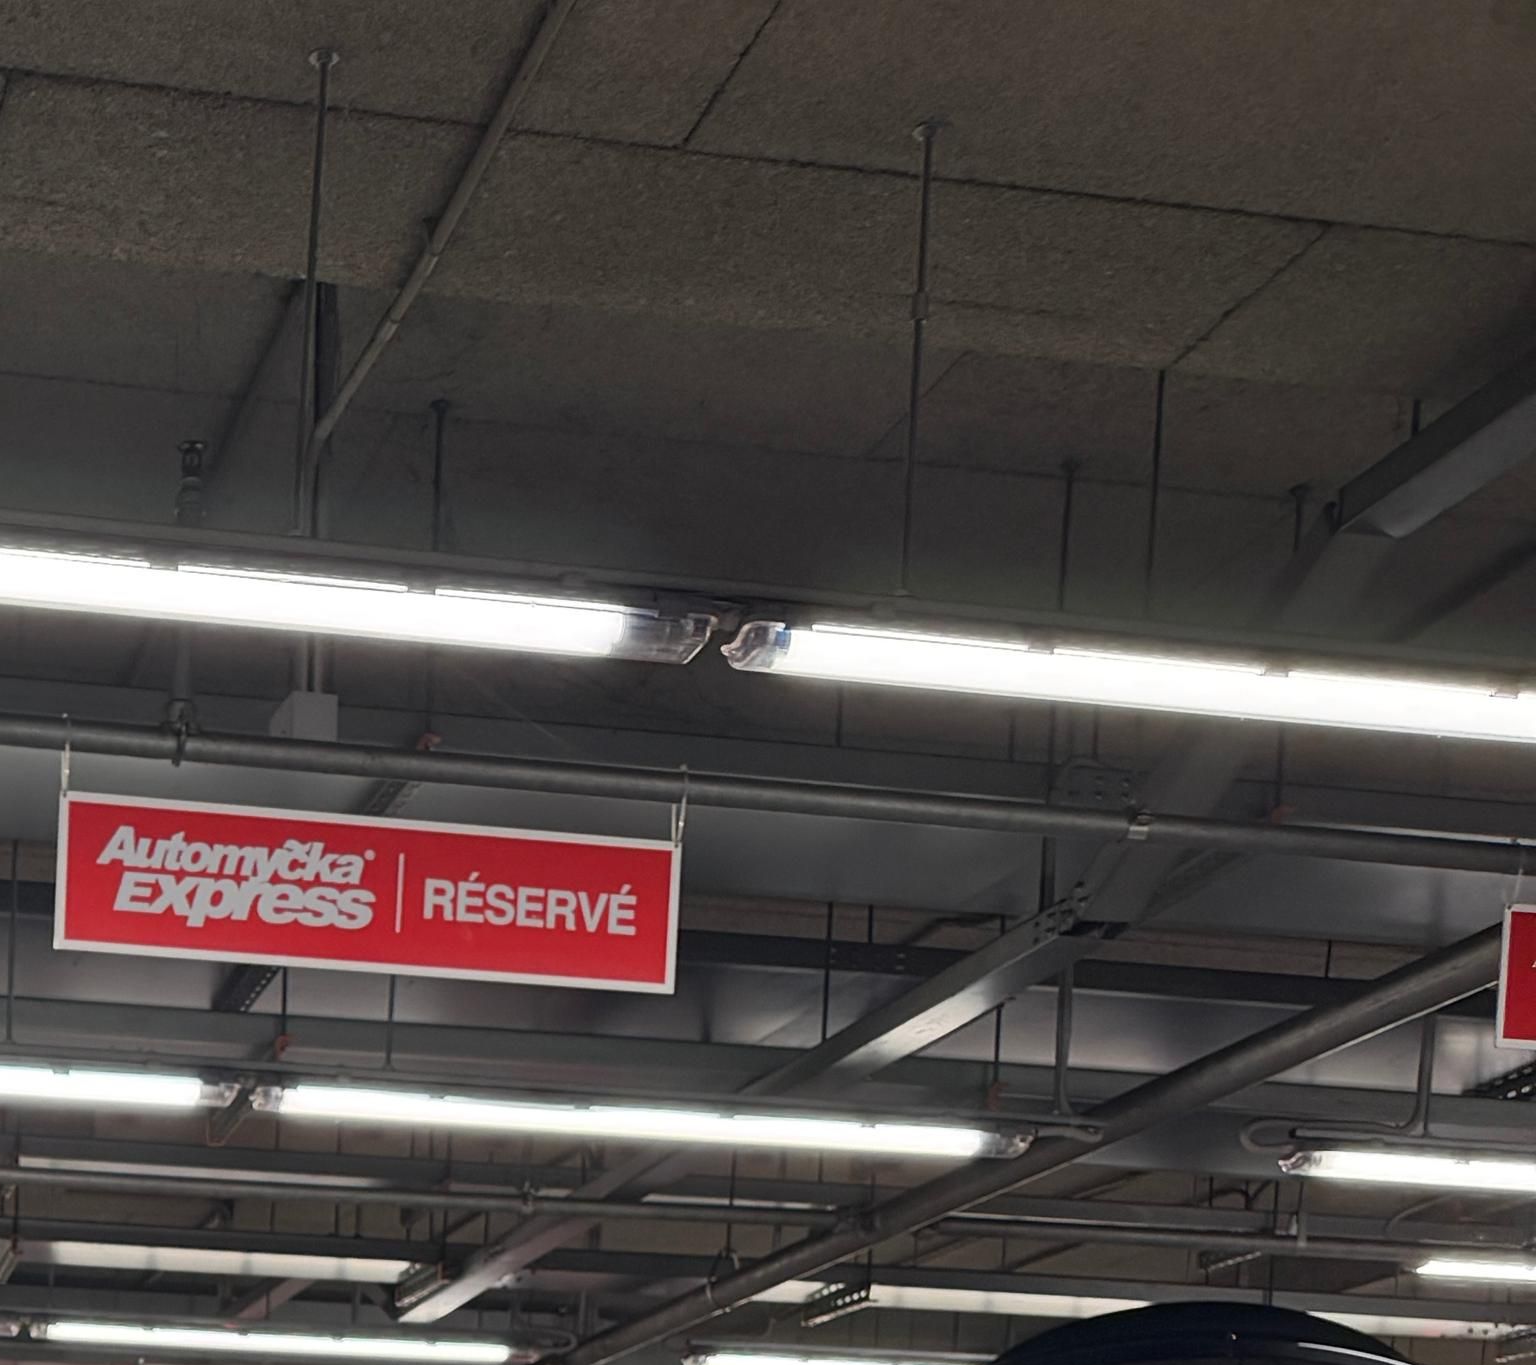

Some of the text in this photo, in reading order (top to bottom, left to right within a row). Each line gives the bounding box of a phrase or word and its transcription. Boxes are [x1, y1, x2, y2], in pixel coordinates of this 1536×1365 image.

[95, 825, 366, 887] Automyčka
[113, 870, 376, 930] Express
[423, 871, 637, 936] RÉSERVÉ
